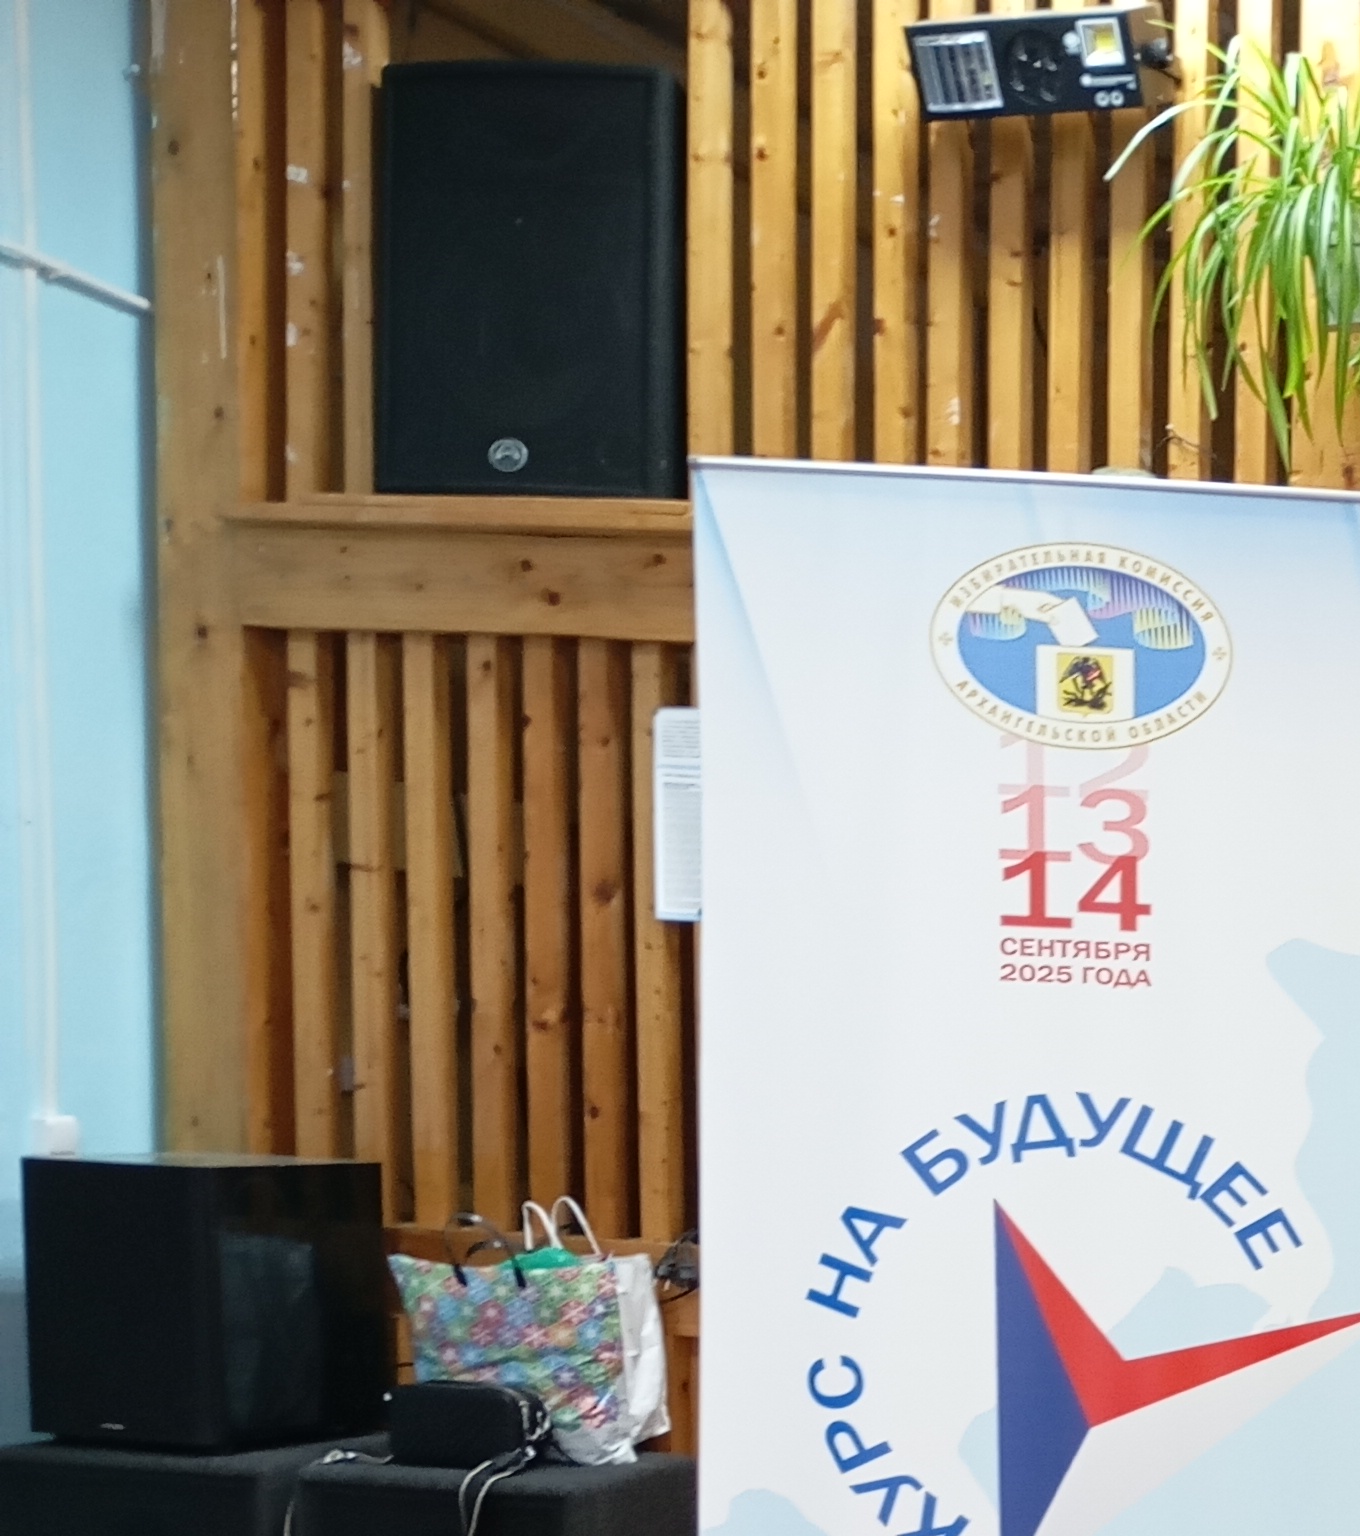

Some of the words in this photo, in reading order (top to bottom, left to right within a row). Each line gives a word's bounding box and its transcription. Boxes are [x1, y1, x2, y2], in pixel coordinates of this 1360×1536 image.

[949, 549, 1106, 609] ИЗБИРАТЕЛЬНАЯ
[1118, 549, 1214, 623] КОМИССИЯ
[955, 680, 1116, 743] АРХАНГЕЛЬСКОЙ
[1129, 691, 1208, 740] ОБЛАСТИ
[998, 785, 1150, 865] 13
[999, 851, 1152, 932] 14
[999, 937, 1152, 962] СЕНТЯБРЯ
[999, 963, 1073, 984] 2025
[1082, 966, 1152, 990] ГОДА
[805, 1205, 908, 1318] НА
[900, 1091, 1303, 1271] БУДУЩЕЕ
